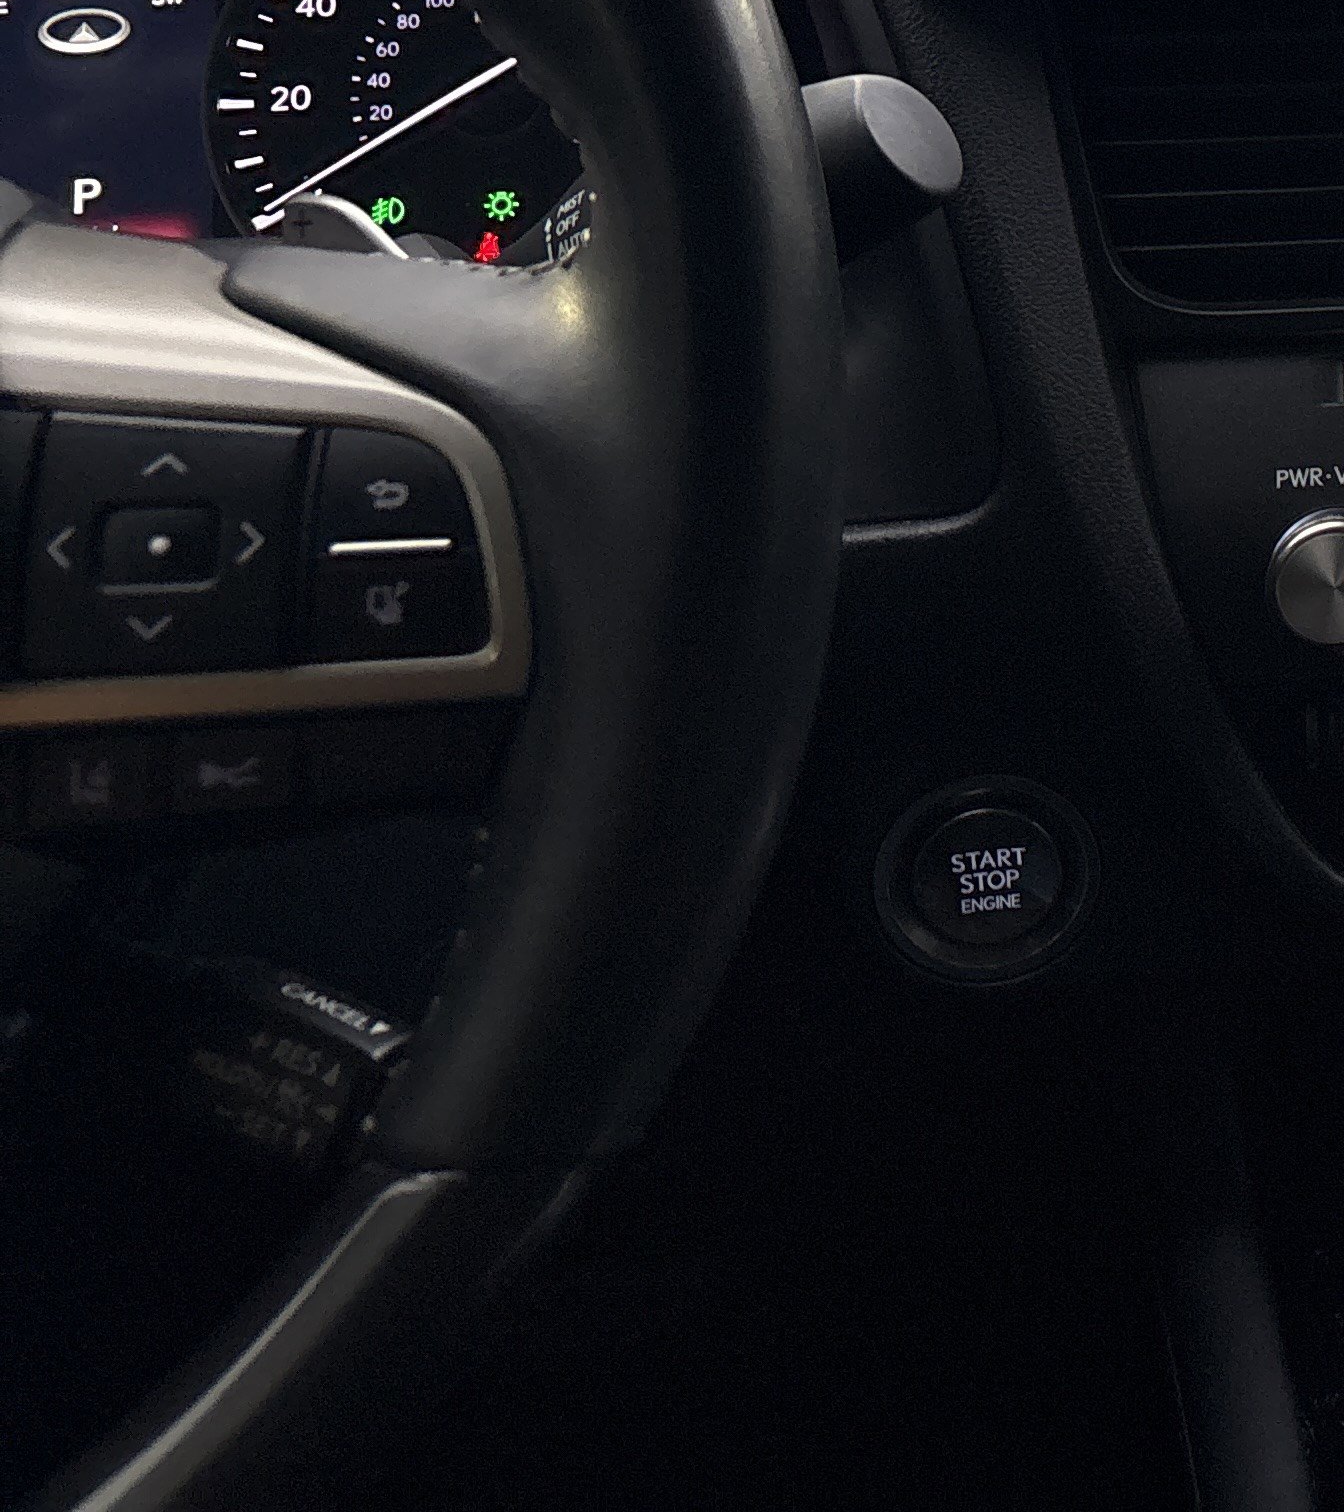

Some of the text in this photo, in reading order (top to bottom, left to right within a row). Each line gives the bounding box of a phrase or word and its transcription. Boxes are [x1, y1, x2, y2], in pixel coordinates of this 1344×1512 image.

[396, 13, 421, 31] 80
[375, 41, 401, 59] 60
[366, 72, 392, 90] 40
[270, 84, 313, 112] 20
[369, 103, 394, 121] 20
[72, 178, 103, 216] P
[555, 208, 581, 237] OFF
[950, 846, 1027, 873] START
[959, 868, 1020, 895] STOP
[961, 893, 1021, 914] ENGINE
